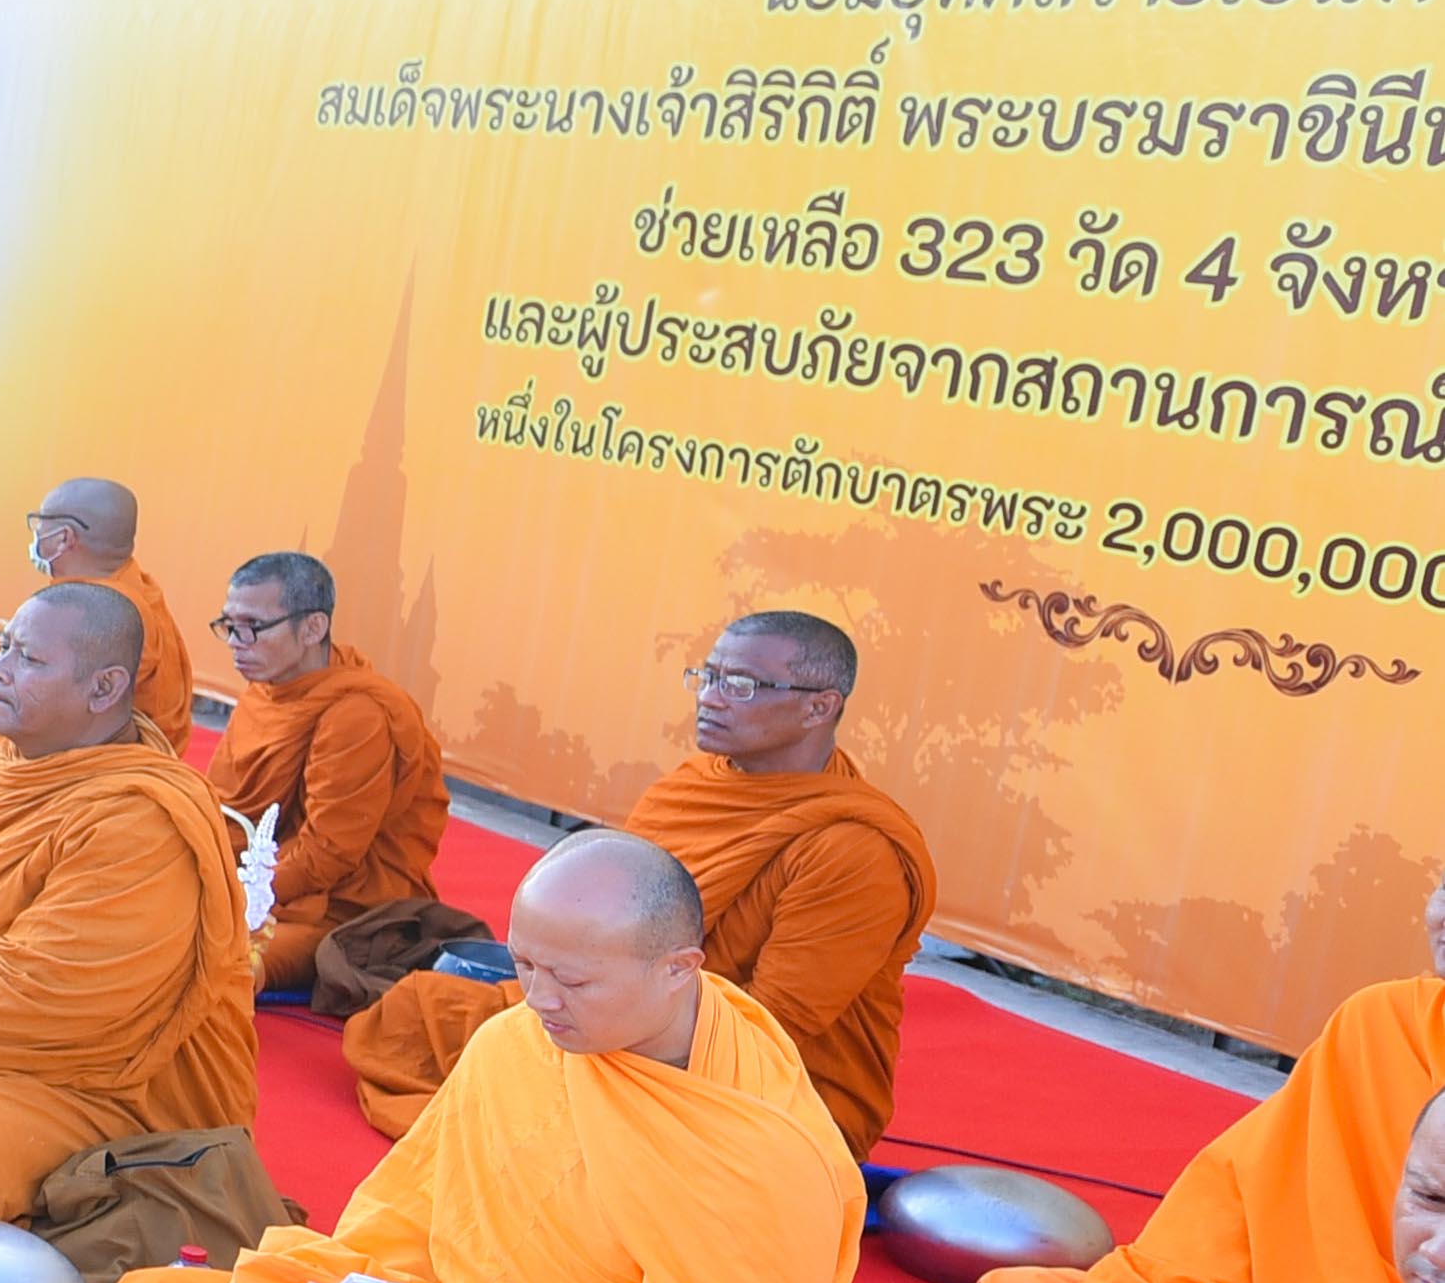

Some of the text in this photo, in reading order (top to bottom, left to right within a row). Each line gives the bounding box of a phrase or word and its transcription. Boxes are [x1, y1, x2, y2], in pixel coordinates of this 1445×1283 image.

[315, 38, 892, 145] สมเด็จพระนางเจ้าสิริกิติ์
[633, 188, 1445, 320] ช่วยเหลือ 323 วัด 4 จังห
[475, 380, 1085, 542] หนึ่งในโครงการตักบาตรพระ
